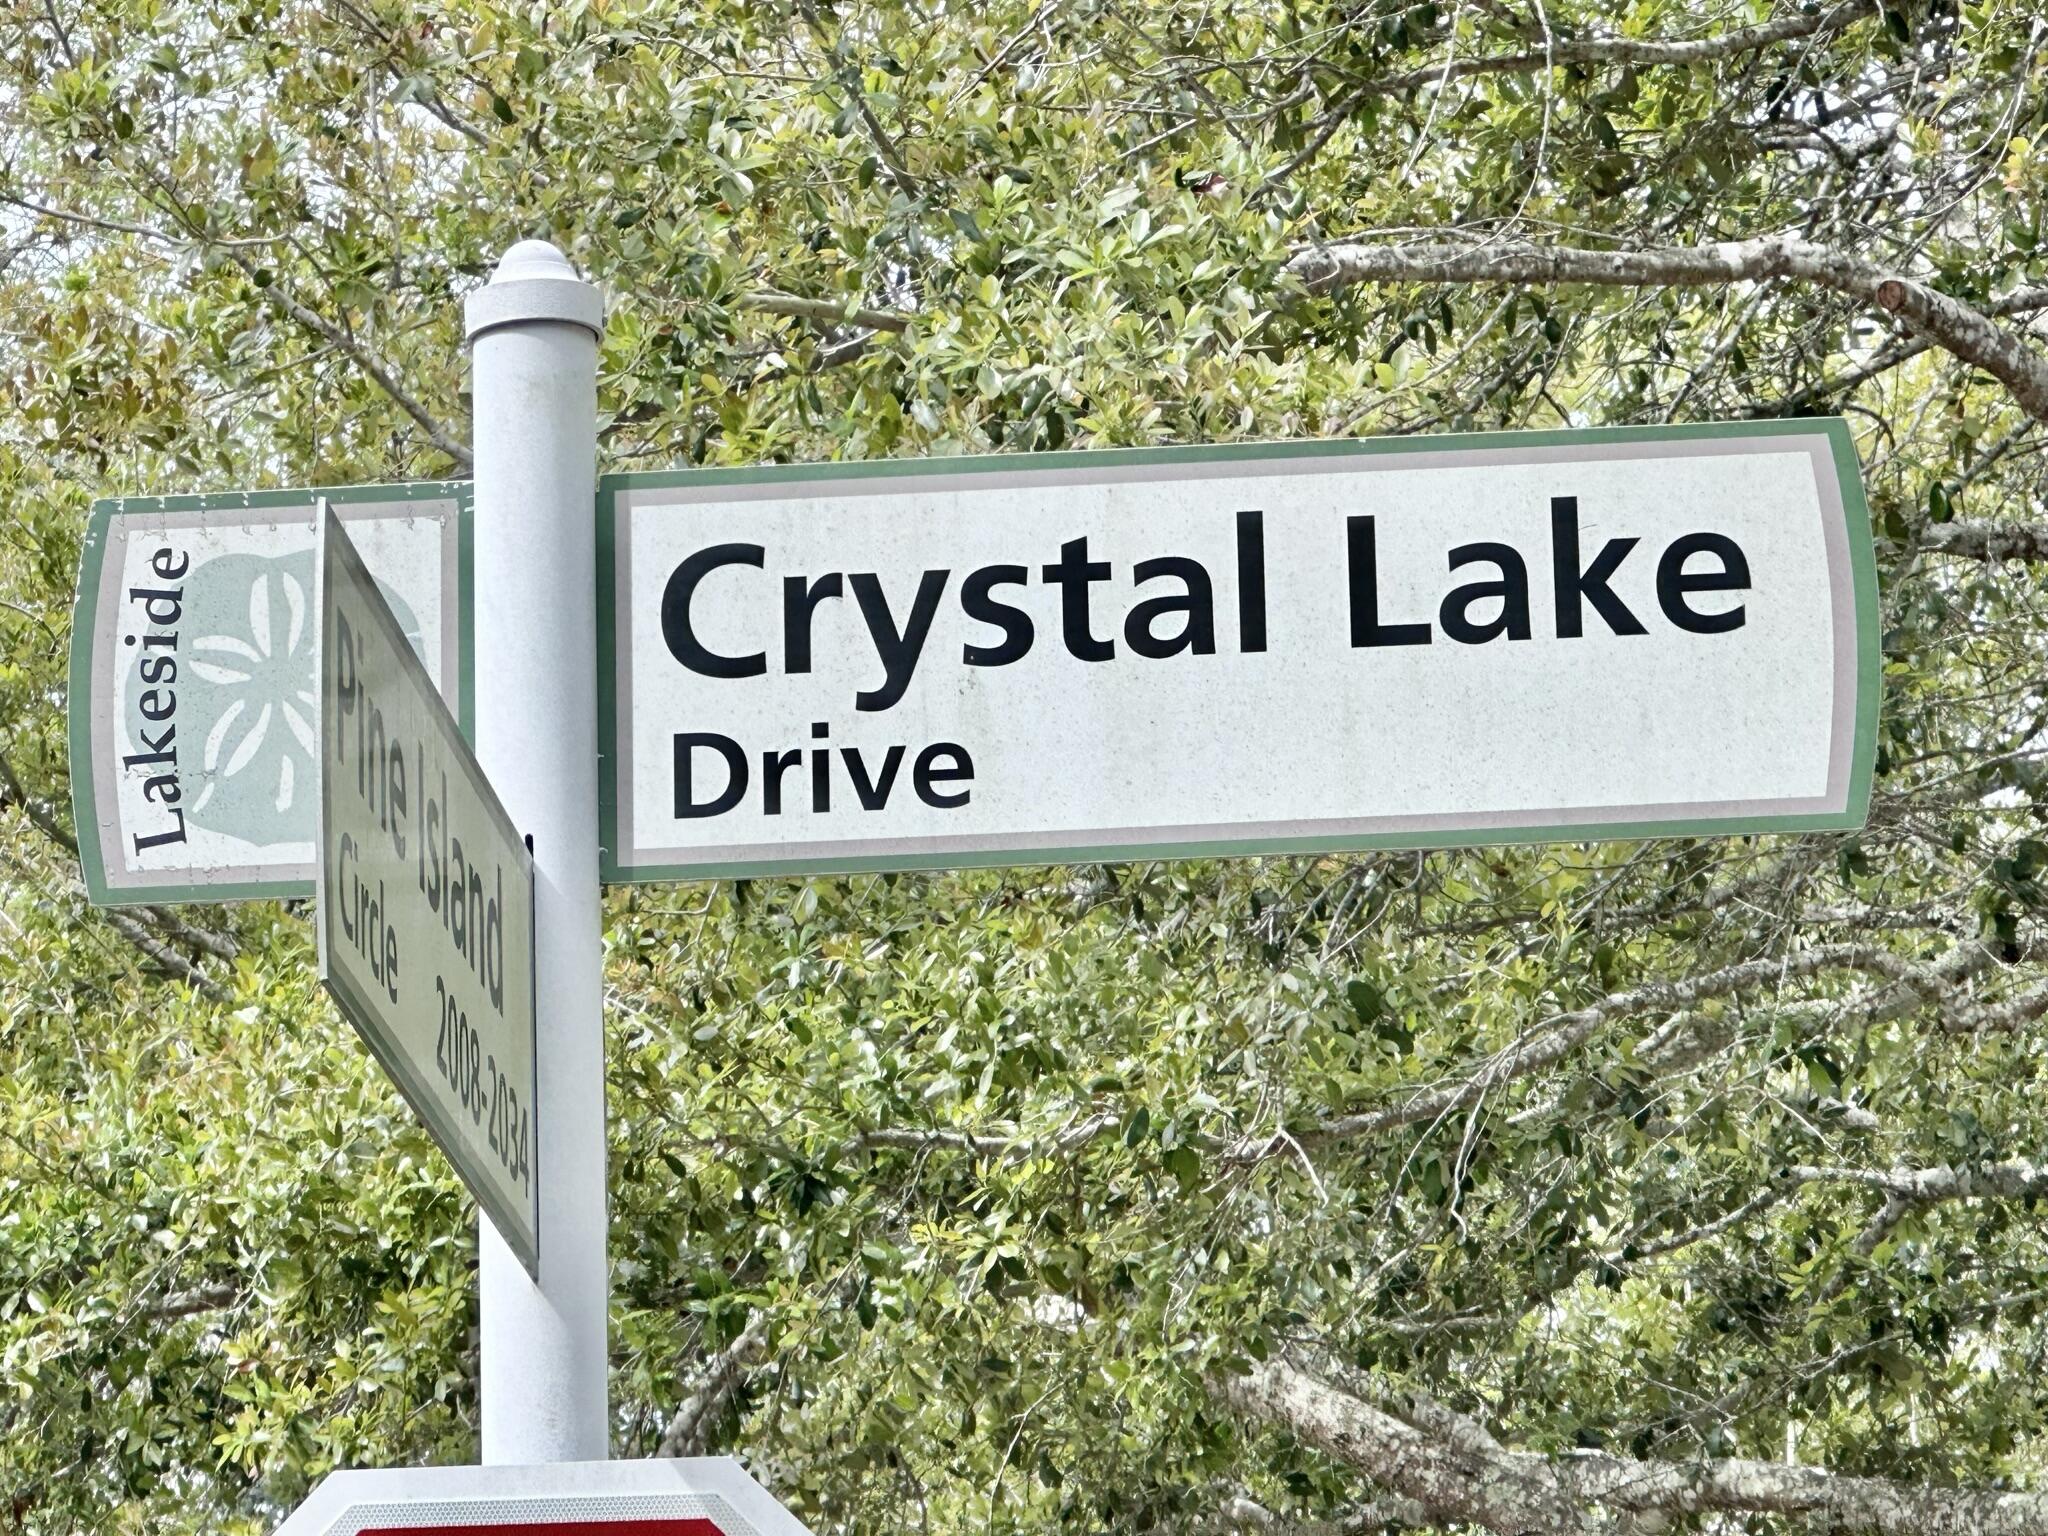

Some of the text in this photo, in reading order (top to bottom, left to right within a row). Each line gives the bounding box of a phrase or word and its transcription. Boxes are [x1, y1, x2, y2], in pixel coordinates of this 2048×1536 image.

[122, 546, 190, 856] Lakeside
[659, 496, 1752, 711] Crystal Lake
[336, 606, 504, 1018] Pine Island
[673, 723, 975, 820] Drive
[339, 832, 398, 1004] Circle
[435, 975, 530, 1199] 2008-2034
